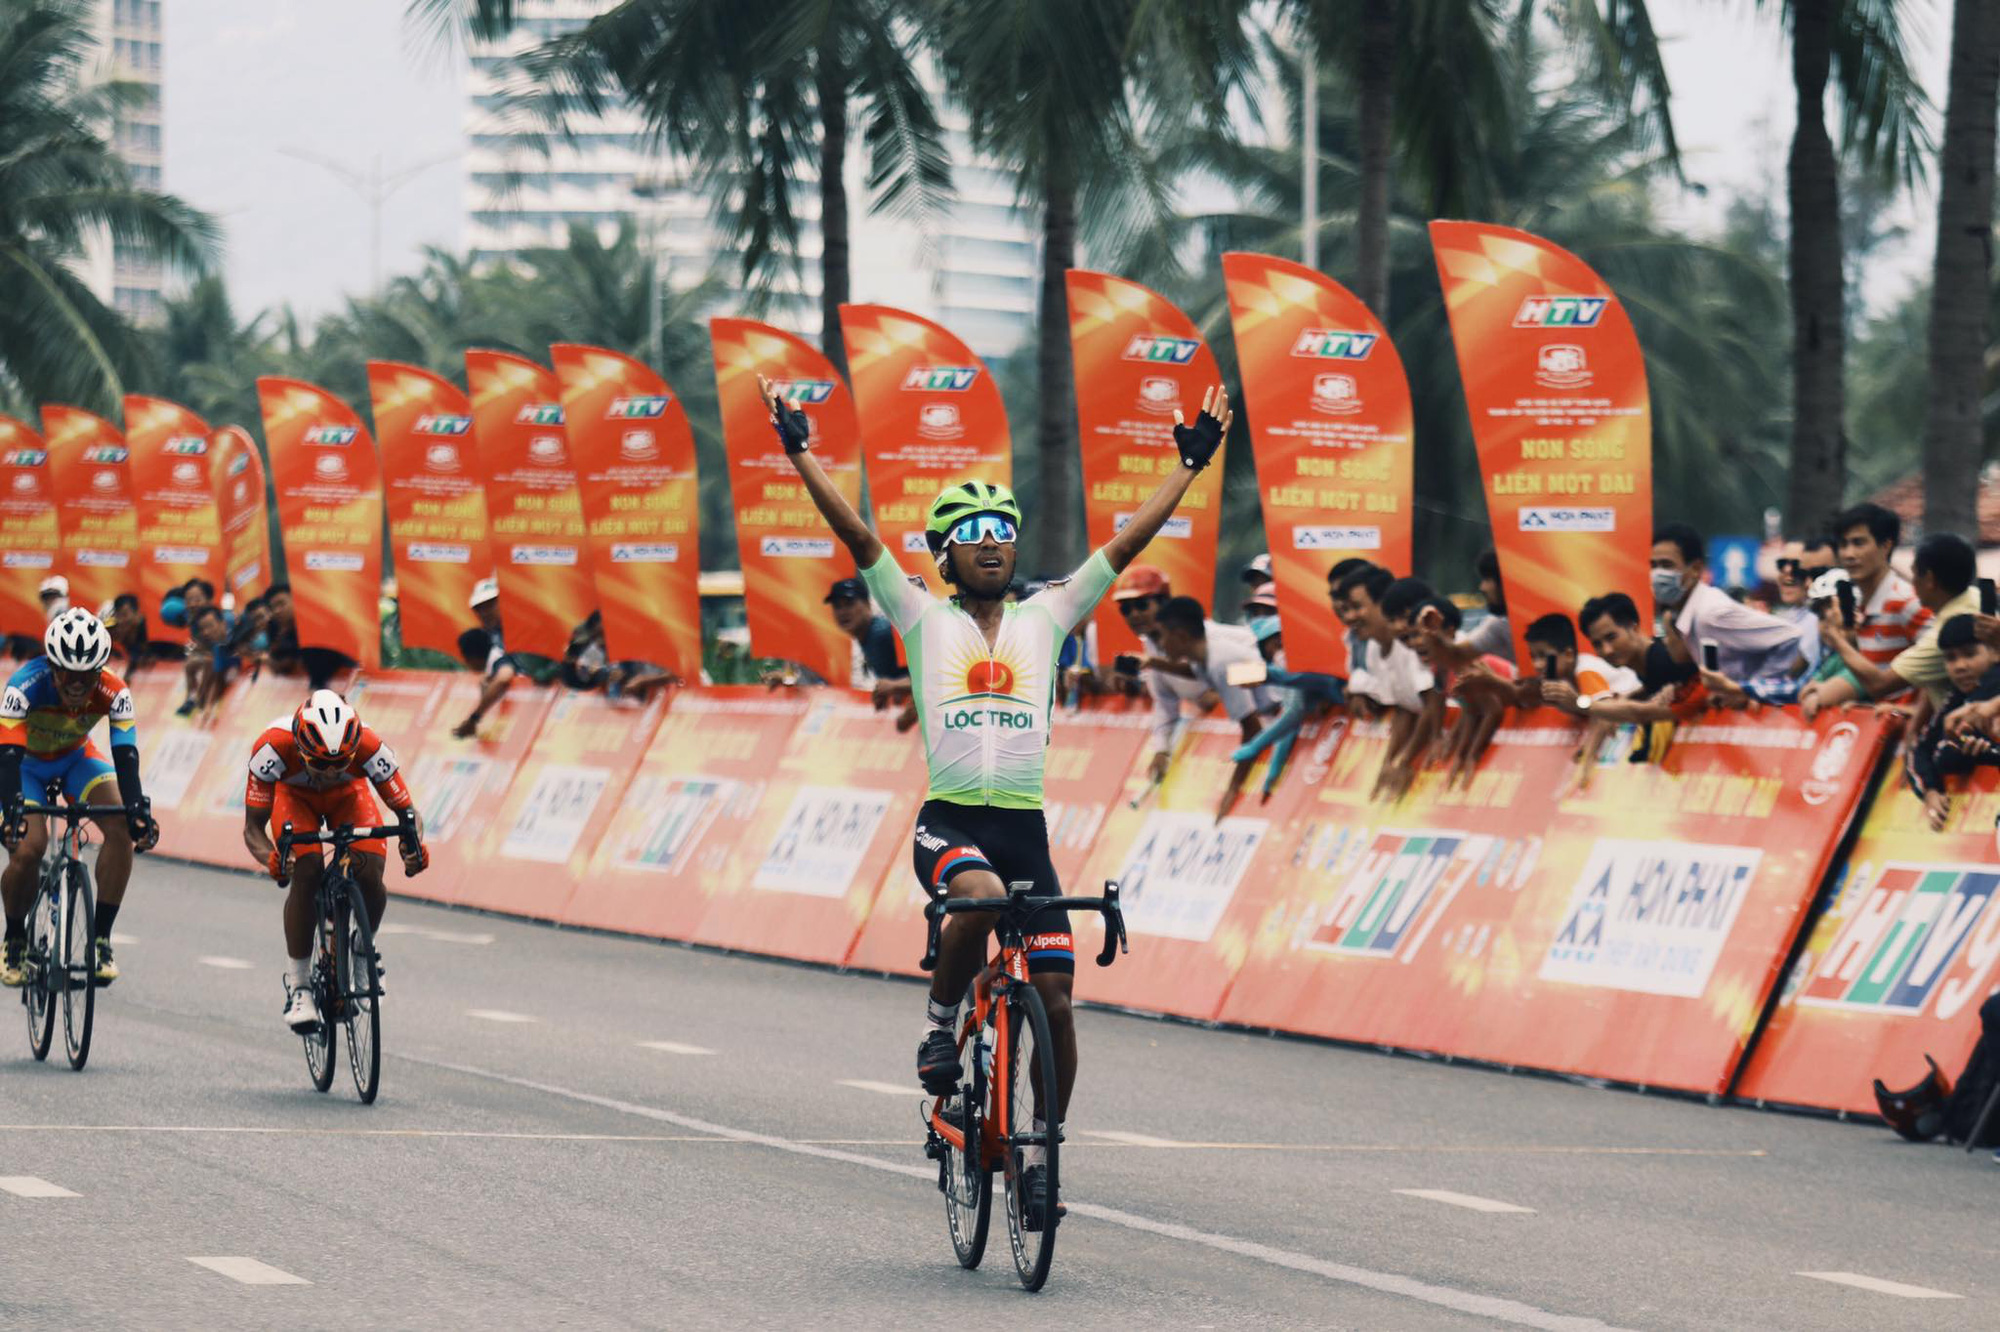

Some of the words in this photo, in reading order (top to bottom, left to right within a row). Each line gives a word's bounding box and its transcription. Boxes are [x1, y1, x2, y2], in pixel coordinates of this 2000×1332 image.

[1514, 298, 1606, 326] HTV
[1124, 337, 1200, 363] HTV
[1293, 330, 1377, 359] HTV
[903, 367, 977, 390] HTV
[1521, 439, 1564, 459] NON
[260, 759, 276, 775] 3
[377, 757, 390, 774] 3
[1316, 832, 1496, 965] HTV7
